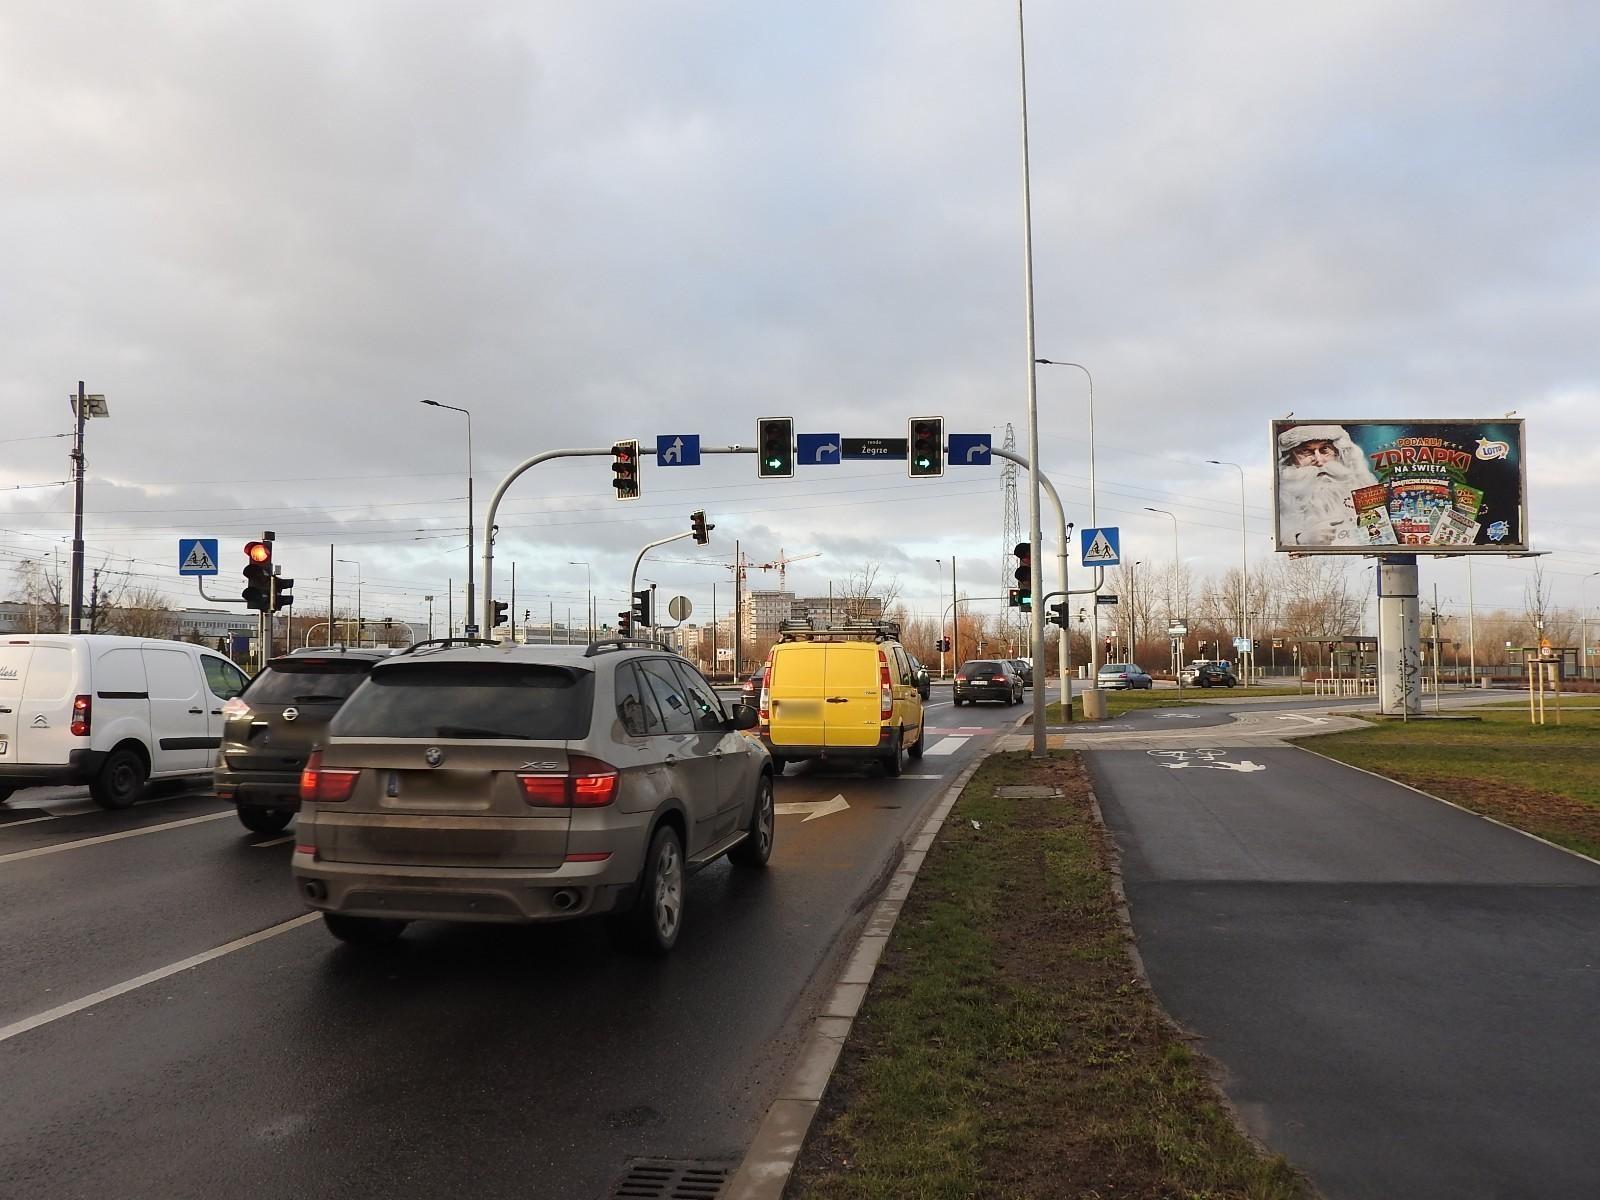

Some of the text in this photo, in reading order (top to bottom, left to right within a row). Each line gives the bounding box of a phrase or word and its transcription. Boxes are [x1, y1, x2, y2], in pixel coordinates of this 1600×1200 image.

[1398, 438, 1442, 447] PODARUJ
[862, 445, 888, 455] Żegrze
[1483, 446, 1502, 456] LOTTO
[1371, 447, 1472, 472] ZDRAPKI
[1394, 463, 1446, 473] NA ŚWIĘTA
[520, 761, 559, 769] X5
